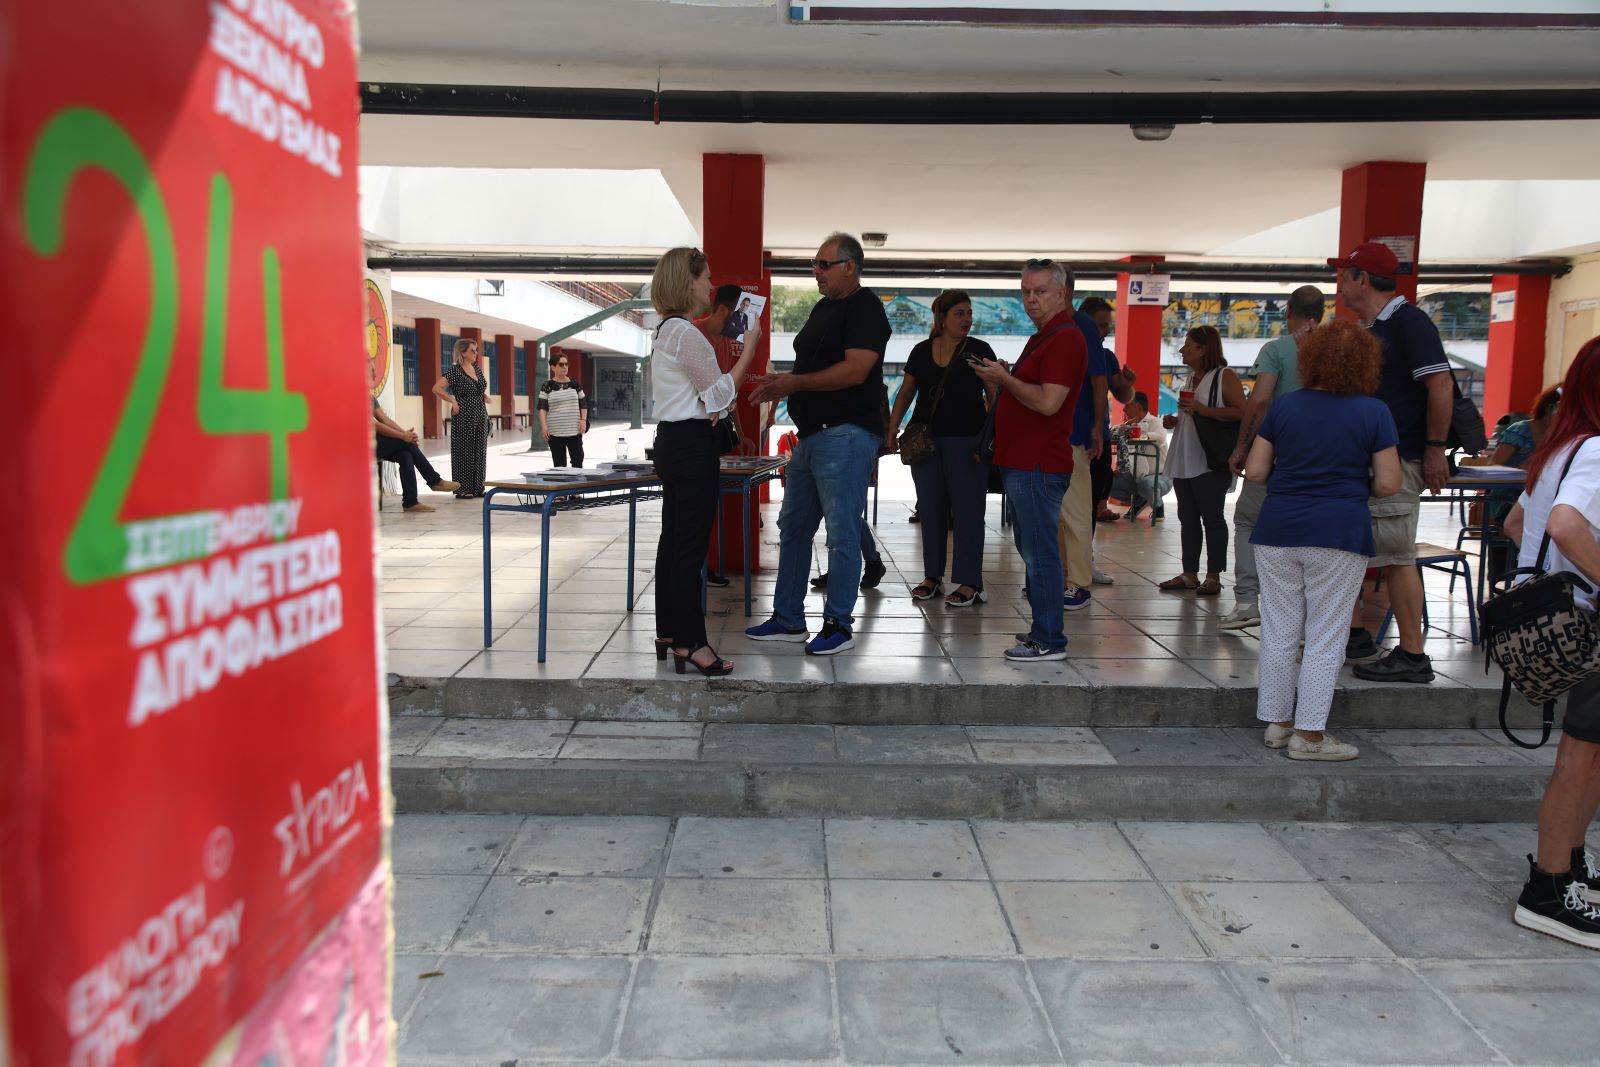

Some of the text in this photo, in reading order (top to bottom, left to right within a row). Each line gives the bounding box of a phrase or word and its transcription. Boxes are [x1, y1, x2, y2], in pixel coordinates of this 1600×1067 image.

[210, 2, 312, 111] ΞΕΚΙΝΑ
[215, 66, 343, 178] ΑΠΟ ΕΜΑΣ
[21, 106, 310, 584] 24
[539, 342, 546, 359] 1
[124, 497, 303, 572] ΣΕΠΤΕΜΒΡΙΟΥ
[127, 528, 342, 648] ΣΥΜΜΕΤΕΧΩ
[127, 582, 343, 728] ΑΠΟΦΑΣΙΖΩ
[273, 759, 369, 878] ΣΥΡΙΖΑ
[68, 882, 207, 1038] ΕΚΛΟΓΗ
